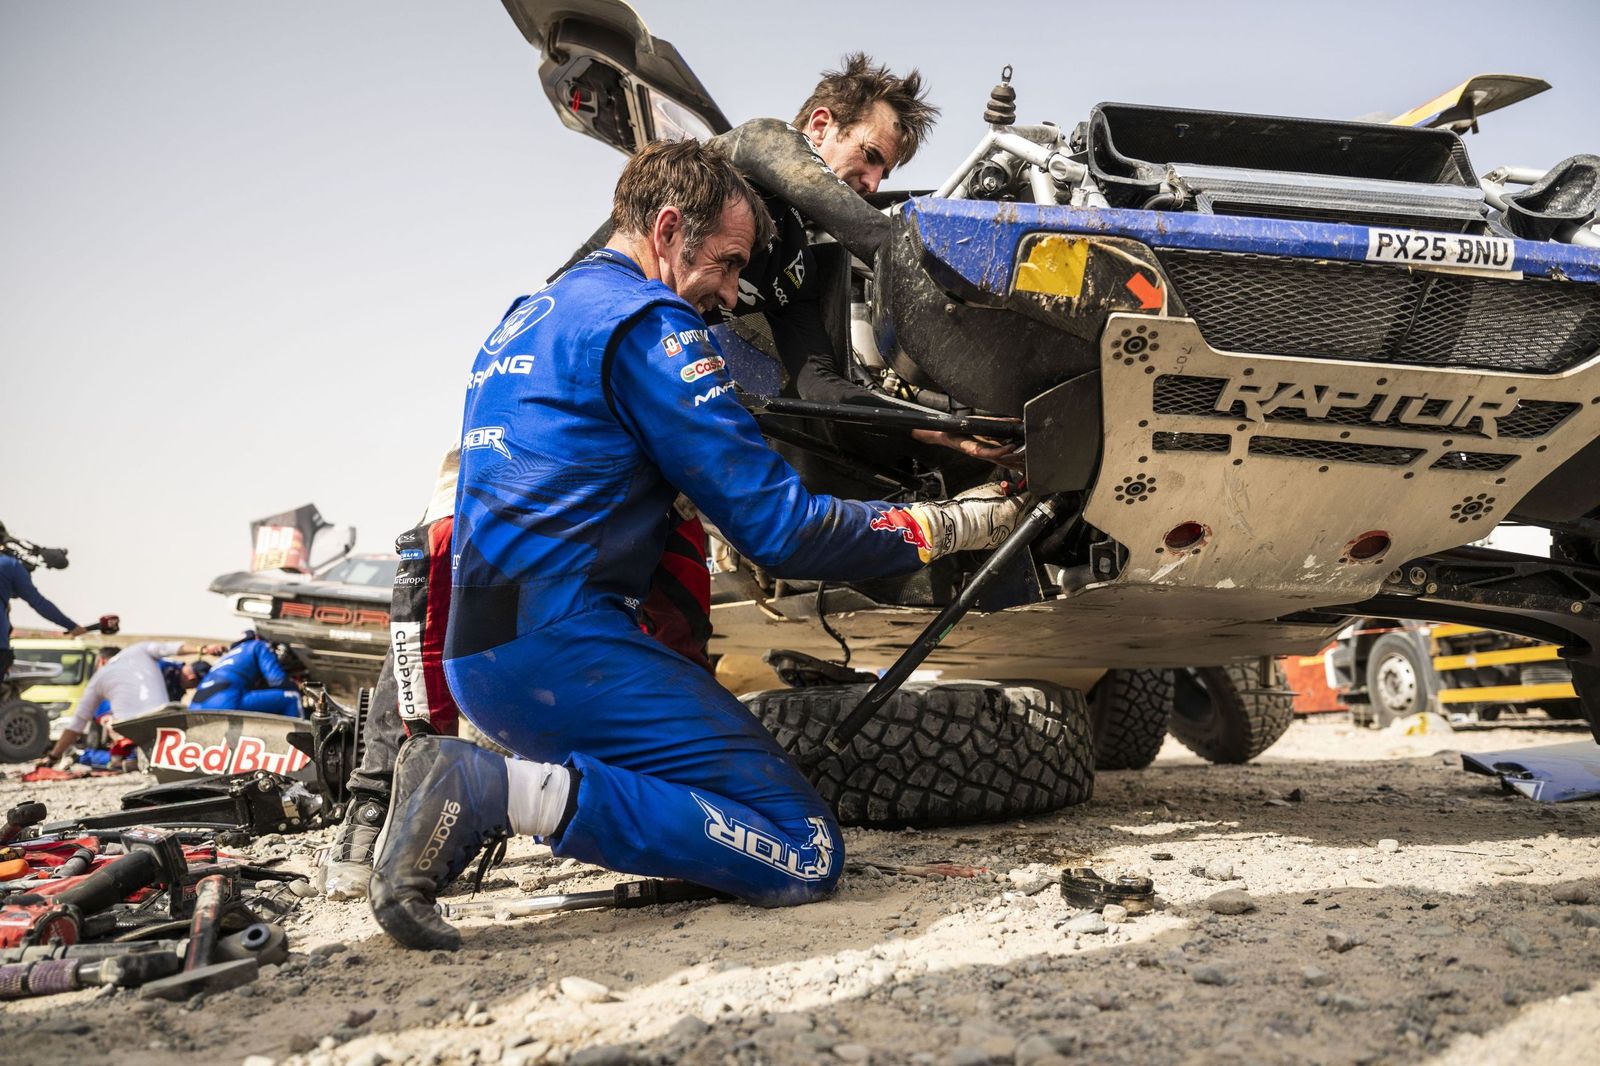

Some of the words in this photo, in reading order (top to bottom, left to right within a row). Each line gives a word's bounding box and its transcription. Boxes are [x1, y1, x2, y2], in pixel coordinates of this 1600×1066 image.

[1375, 232, 1447, 262] PX25
[1456, 238, 1509, 266] BNU
[1214, 377, 1521, 440] RAPTOR
[280, 601, 391, 627] FOR
[395, 630, 416, 716] CHOPARD
[152, 729, 231, 774] Red
[415, 799, 461, 871] sparco
